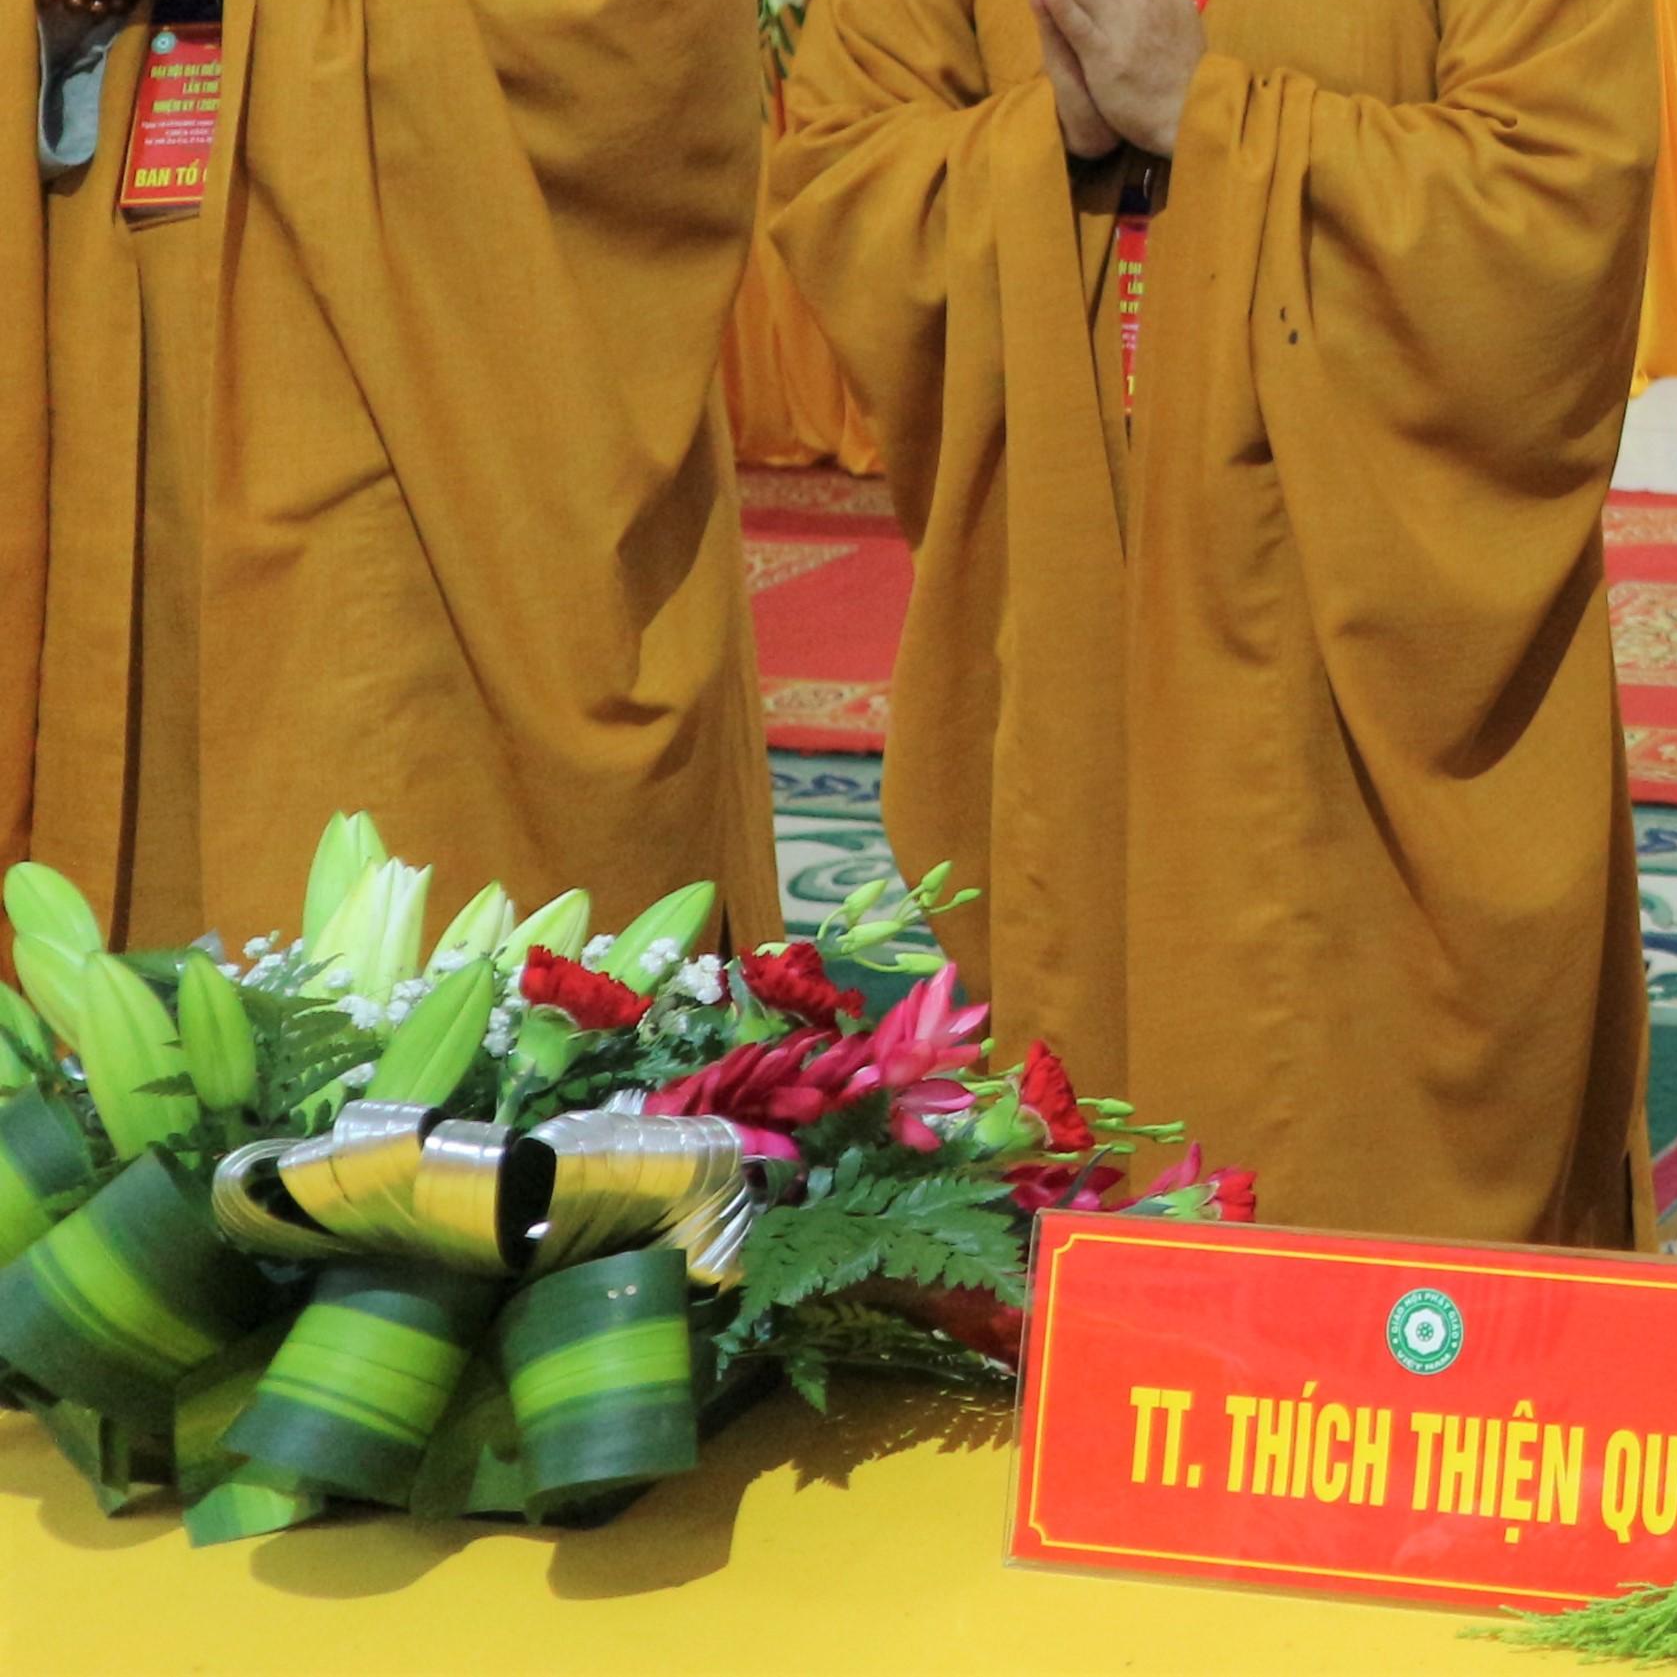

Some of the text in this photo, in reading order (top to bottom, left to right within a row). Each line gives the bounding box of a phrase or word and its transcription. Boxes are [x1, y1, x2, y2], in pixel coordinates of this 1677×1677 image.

[134, 158, 198, 188] BAN TỔ
[1404, 1293, 1422, 1307] HỘI
[1424, 1292, 1451, 1310] PHẬT
[1397, 1350, 1452, 1371] VIỆT NAM
[1130, 1386, 1201, 1488] TT.
[1226, 1381, 1391, 1507] THÍCH
[1411, 1400, 1584, 1544] THIỆN
